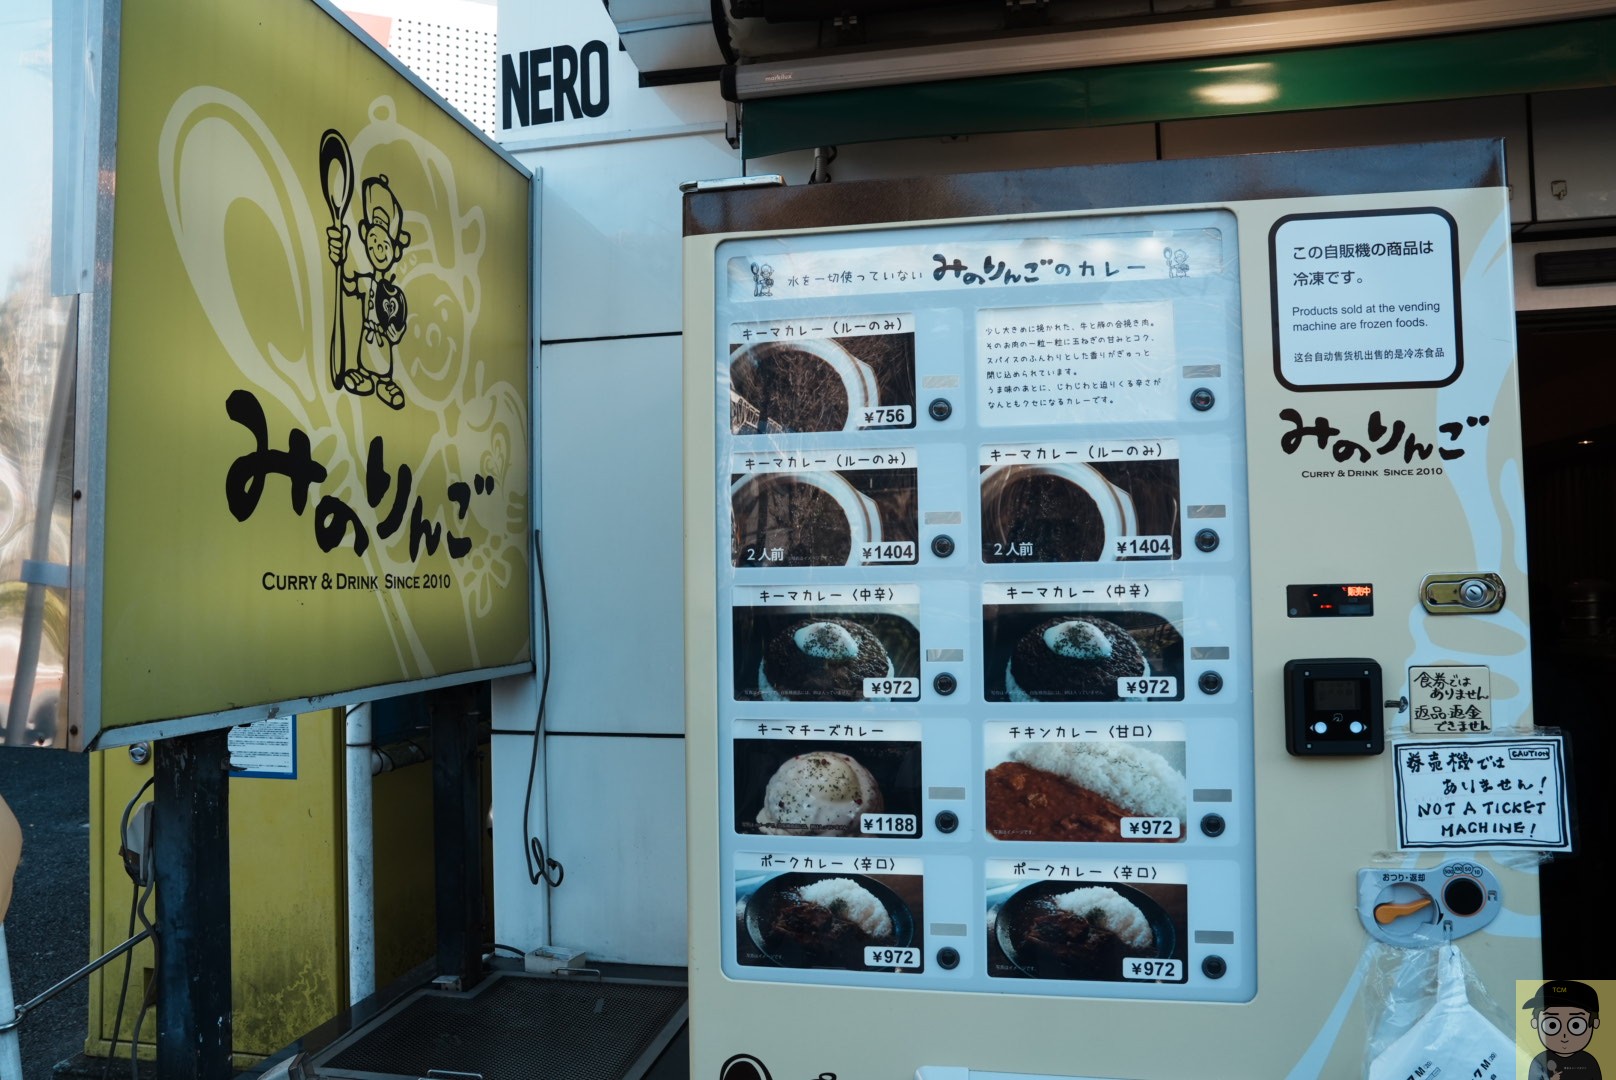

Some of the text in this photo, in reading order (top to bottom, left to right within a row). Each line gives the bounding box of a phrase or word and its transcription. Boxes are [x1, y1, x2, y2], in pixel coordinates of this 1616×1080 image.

[502, 39, 610, 130] NERO
[1293, 240, 1434, 260] この自販機の商品は
[787, 269, 923, 287] 水を一切使っていない
[1293, 270, 1363, 286] 冷凍です。
[1292, 301, 1440, 316] Products sold at the vending
[1293, 317, 1428, 332] machine are frozen foods.
[1294, 347, 1445, 363] 这台自动售货机出售的是冷冻食品
[986, 368, 1078, 380] 閉じ込められています。
[988, 395, 1114, 410] なんともクセになるカレーです。
[864, 408, 905, 424] ¥756
[1279, 408, 1490, 463] みのりんご
[225, 389, 494, 562] みのりんご
[1416, 467, 1443, 475] 2010
[862, 544, 913, 560] ¥1404
[993, 542, 1034, 556] 2人前
[1116, 538, 1171, 555] ¥1404
[747, 547, 785, 562] 2人前
[321, 573, 332, 590] &
[423, 574, 450, 589] 2010
[871, 680, 912, 695] ¥972
[1126, 679, 1170, 694] ¥972
[1413, 671, 1471, 690] 食券では
[1430, 686, 1489, 700] ありません
[758, 723, 884, 737] キーマチーズカレー
[1434, 720, 1491, 731] できません
[1511, 749, 1549, 758] CAUTION
[1406, 751, 1505, 773] 券売機では
[1418, 800, 1546, 817] NOT A TICKET
[863, 817, 914, 832] ¥1188
[1129, 820, 1173, 835] ¥972
[1441, 822, 1536, 838] MACHINE!
[1382, 873, 1426, 882] おつり・返却
[872, 950, 913, 964] ¥972
[1131, 962, 1175, 977] ¥972
